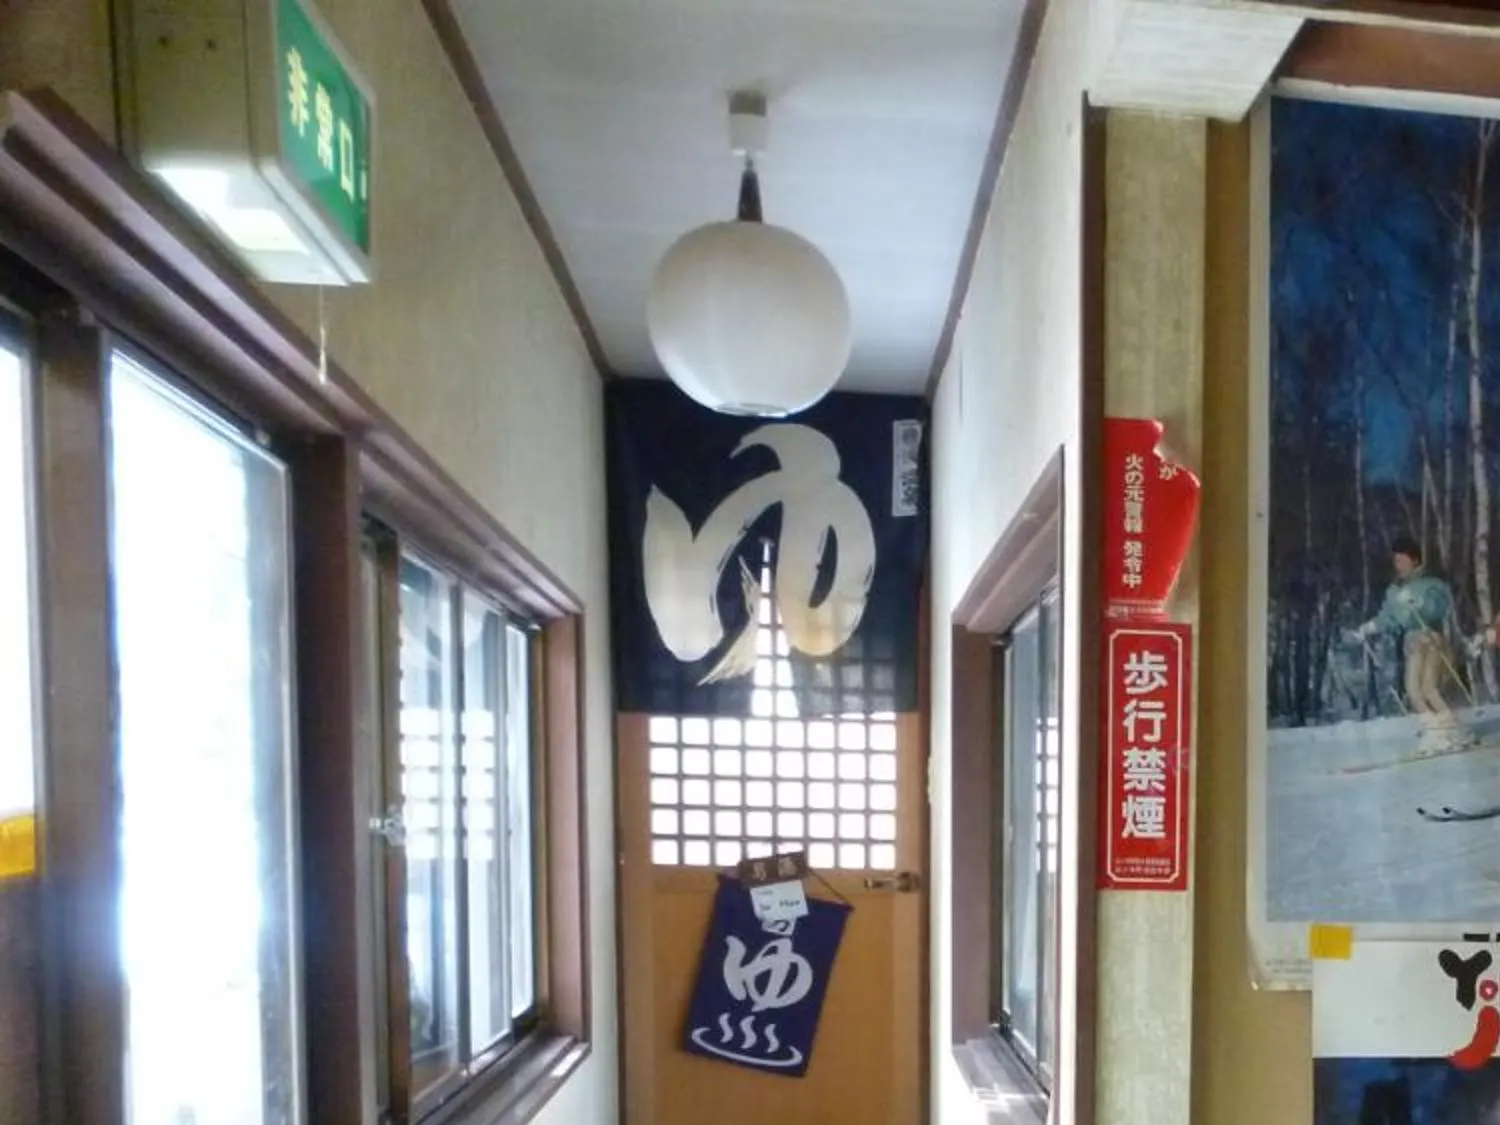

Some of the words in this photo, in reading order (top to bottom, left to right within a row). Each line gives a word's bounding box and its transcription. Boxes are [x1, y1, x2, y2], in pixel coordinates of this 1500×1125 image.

[642, 422, 876, 686] ゆ
[1121, 650, 1169, 840] 歩行禁煙
[723, 935, 813, 1012] ゆ
